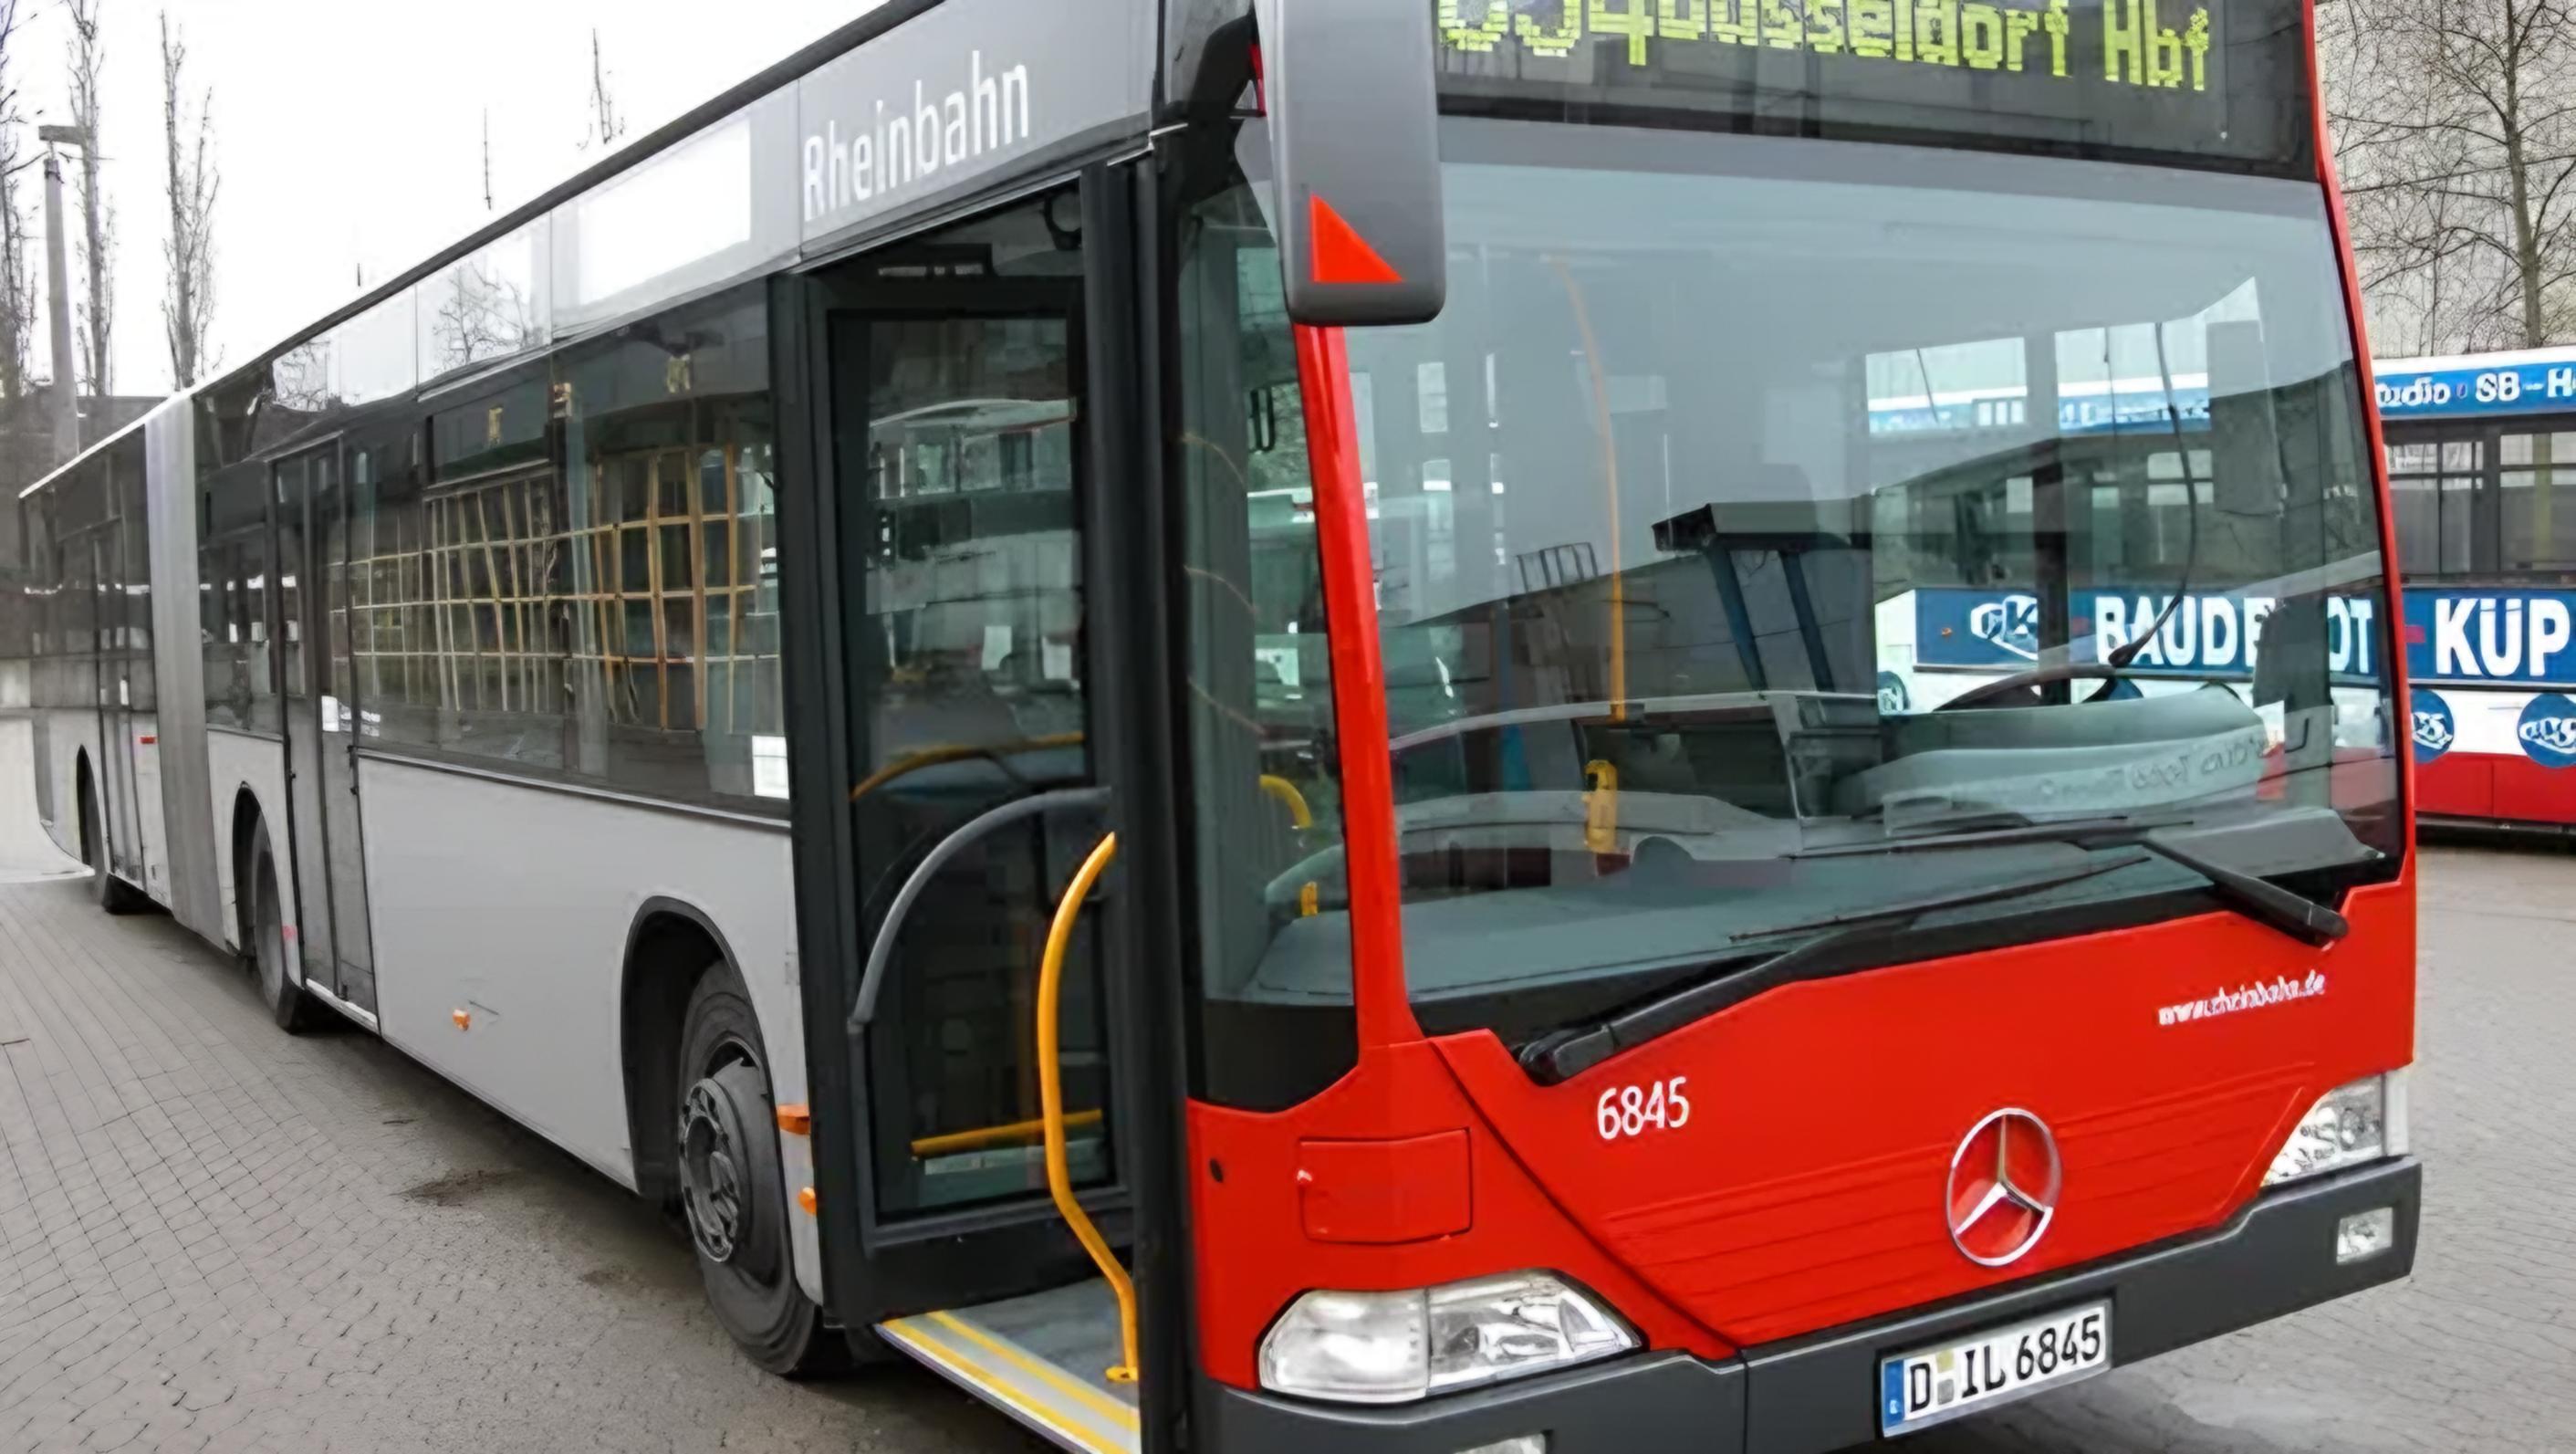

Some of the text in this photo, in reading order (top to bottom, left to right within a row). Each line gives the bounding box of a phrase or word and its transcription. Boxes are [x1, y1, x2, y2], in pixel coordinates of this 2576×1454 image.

[804, 50, 1028, 222] Rheinbahn
[2476, 368, 2576, 402] SB-H
[1598, 1076, 1690, 1140] 6845
[1910, 1313, 2101, 1413] D IL 6845
